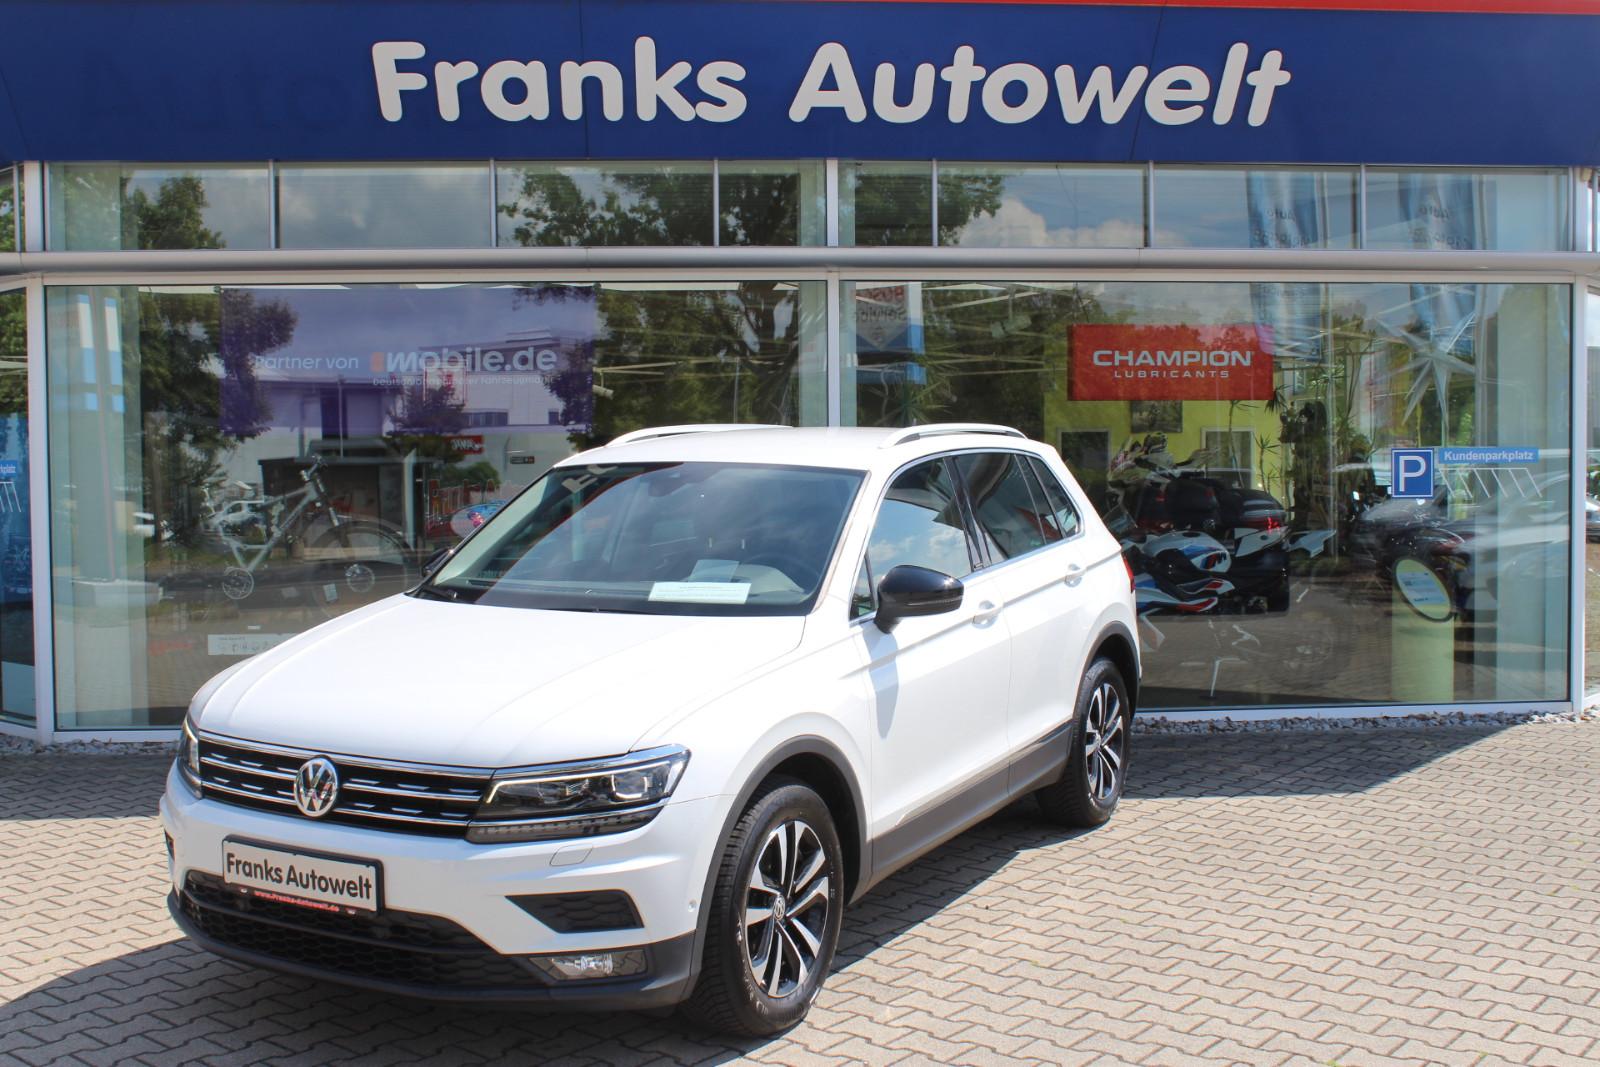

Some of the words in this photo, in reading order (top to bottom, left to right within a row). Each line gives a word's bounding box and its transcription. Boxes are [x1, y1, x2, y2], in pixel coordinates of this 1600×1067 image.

[371, 36, 747, 122] Franks
[788, 41, 1292, 126] Autowelt
[255, 355, 323, 369] Partner
[327, 357, 359, 369] von
[387, 347, 558, 373] mobile.de
[1093, 350, 1251, 367] CHAMPION
[1114, 370, 1230, 378] LUBRICANTS
[1443, 450, 1535, 463] Kundenparkplatz
[1398, 455, 1427, 492] P
[226, 852, 283, 884] Franks
[286, 865, 372, 899] Autowelt
